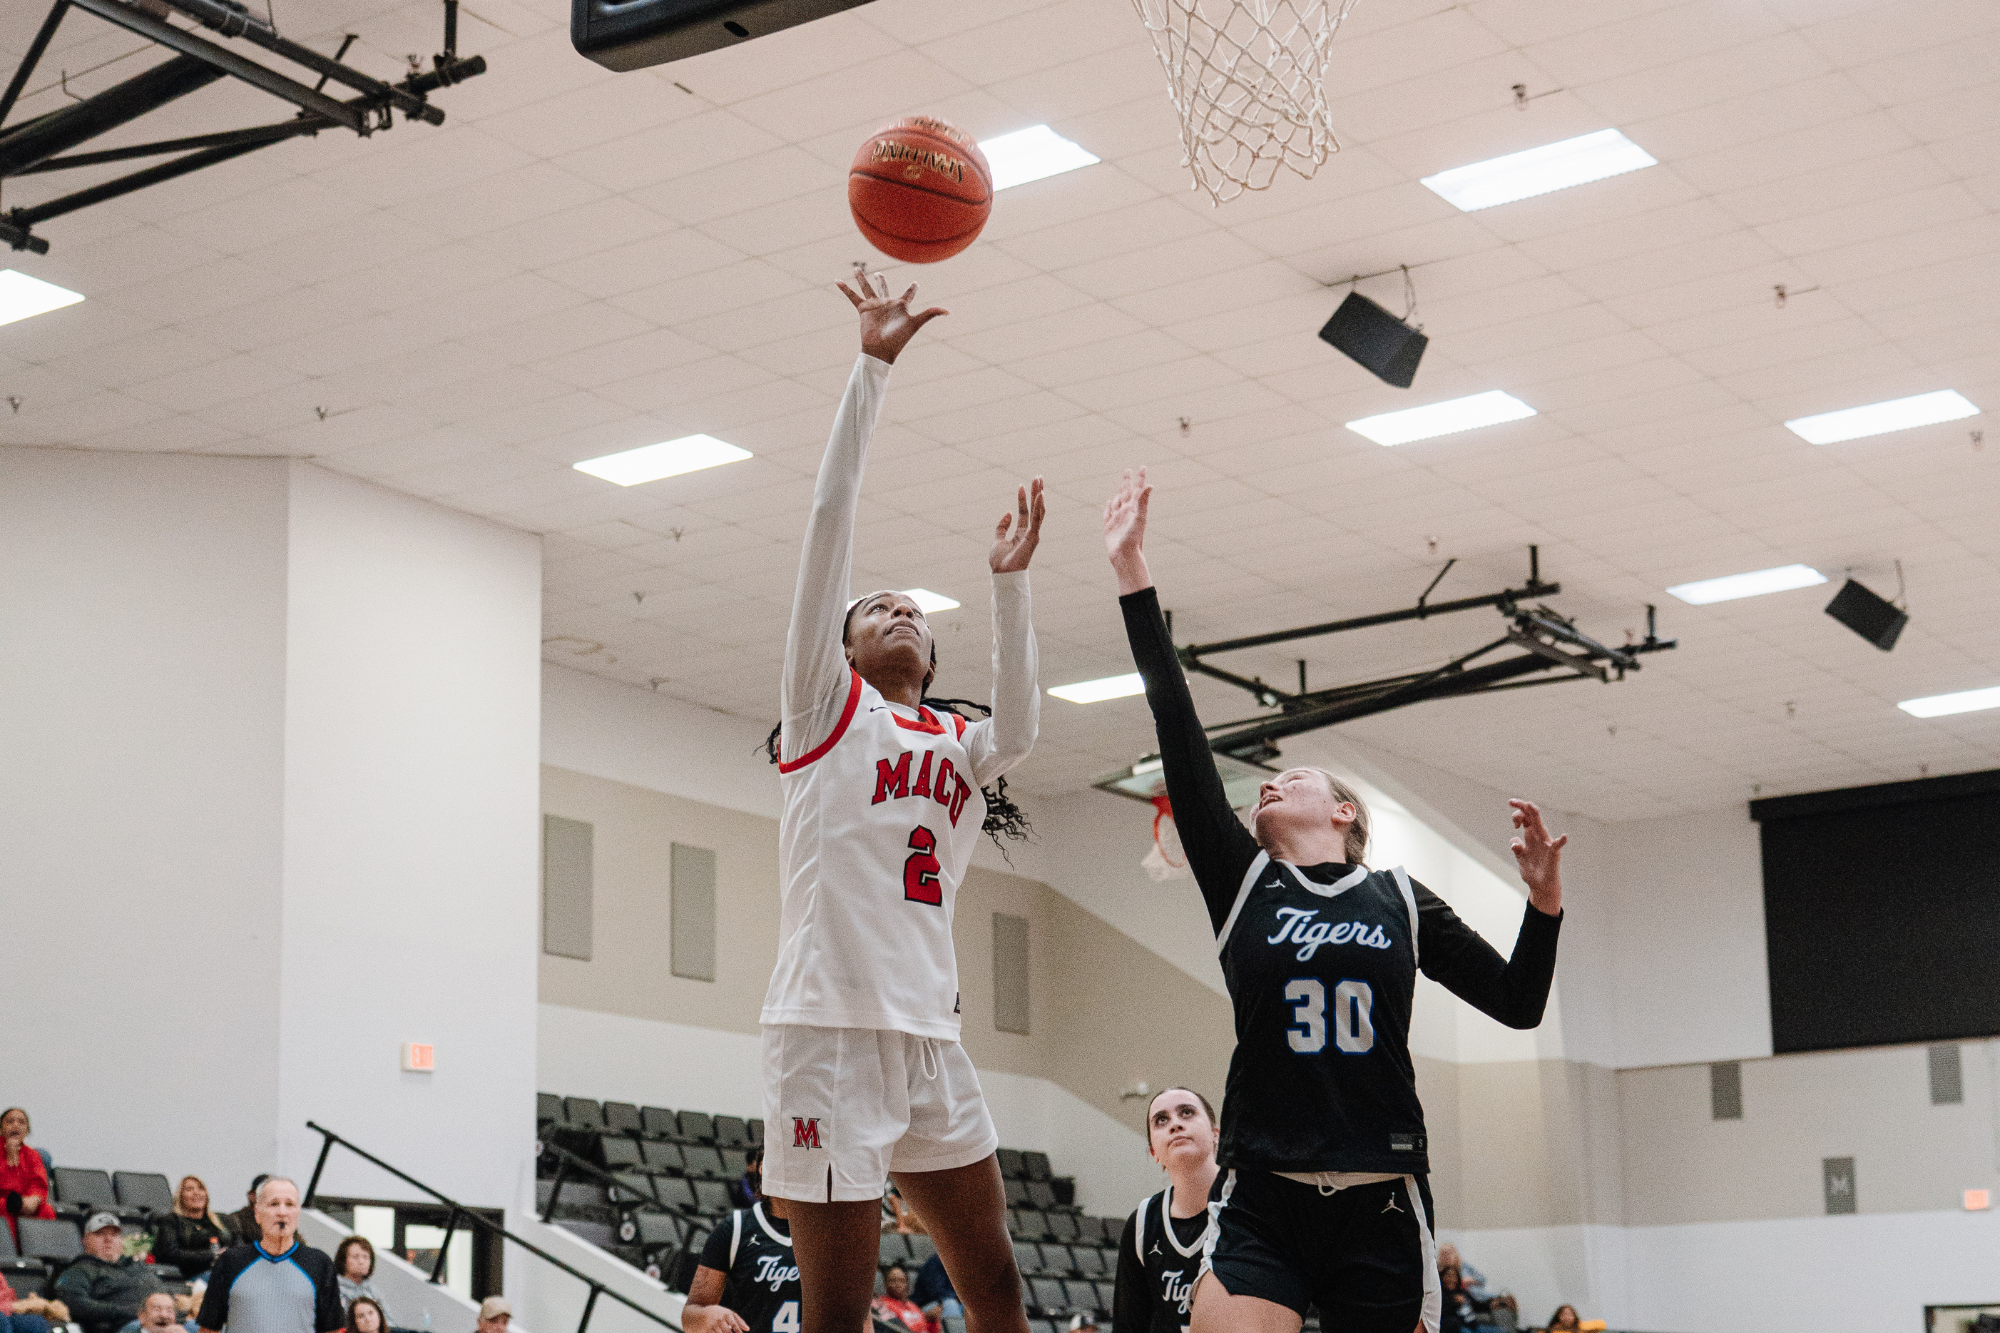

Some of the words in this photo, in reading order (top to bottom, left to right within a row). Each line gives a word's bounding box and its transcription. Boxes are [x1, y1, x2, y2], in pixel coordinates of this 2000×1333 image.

[871, 749, 972, 829] MACU
[903, 825, 942, 907] 2
[1267, 906, 1392, 962] Tigers
[1282, 977, 1377, 1056] 30
[791, 1116, 822, 1151] M
[754, 1255, 800, 1293] Tige
[1161, 1269, 1192, 1314] Tig
